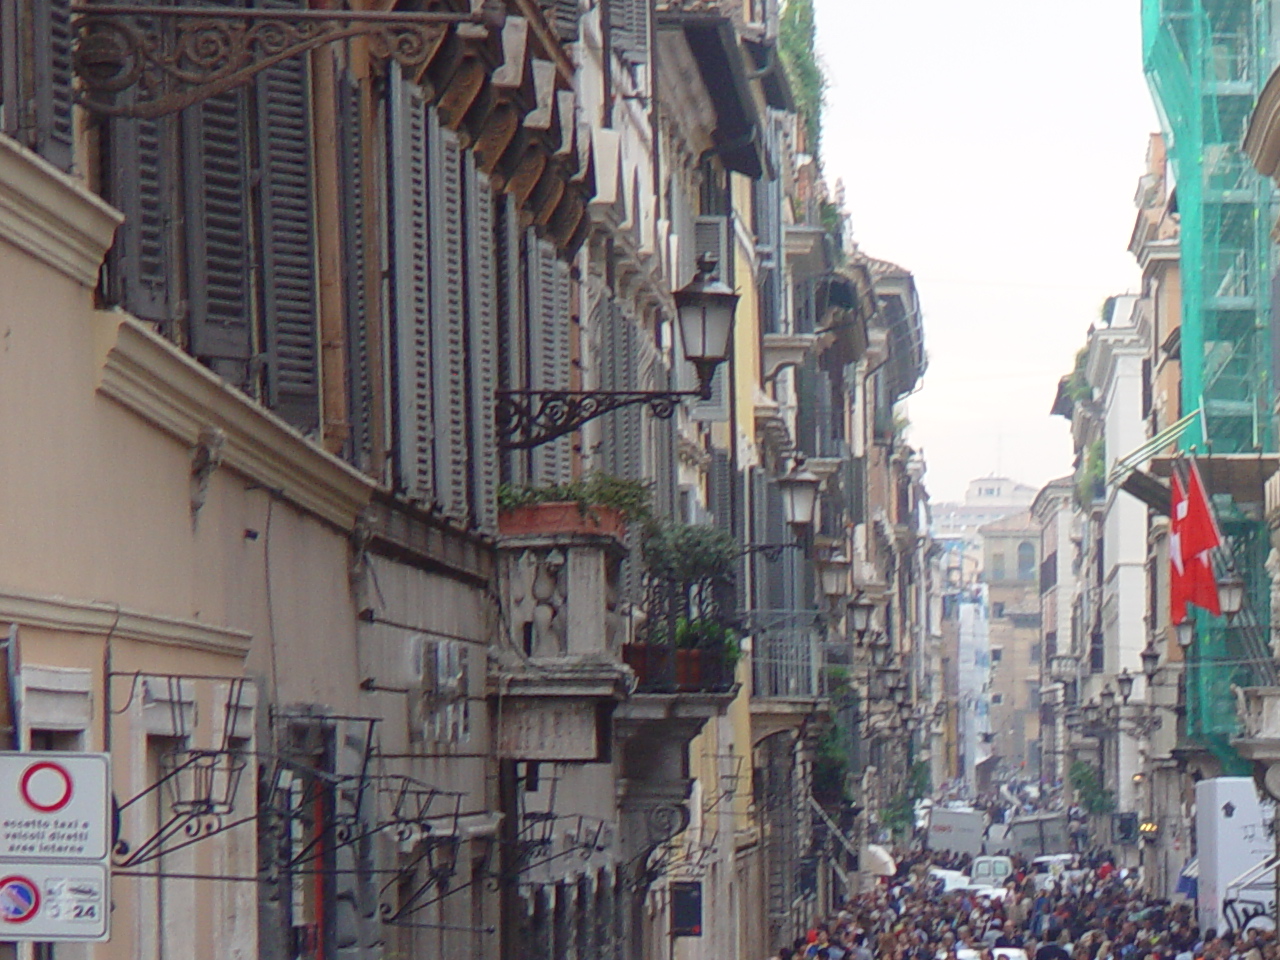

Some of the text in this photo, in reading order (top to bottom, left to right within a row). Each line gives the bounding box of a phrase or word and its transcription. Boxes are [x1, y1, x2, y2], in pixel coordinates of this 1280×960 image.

[53, 819, 79, 829] taxi
[4, 831, 89, 841] veicoli diretti
